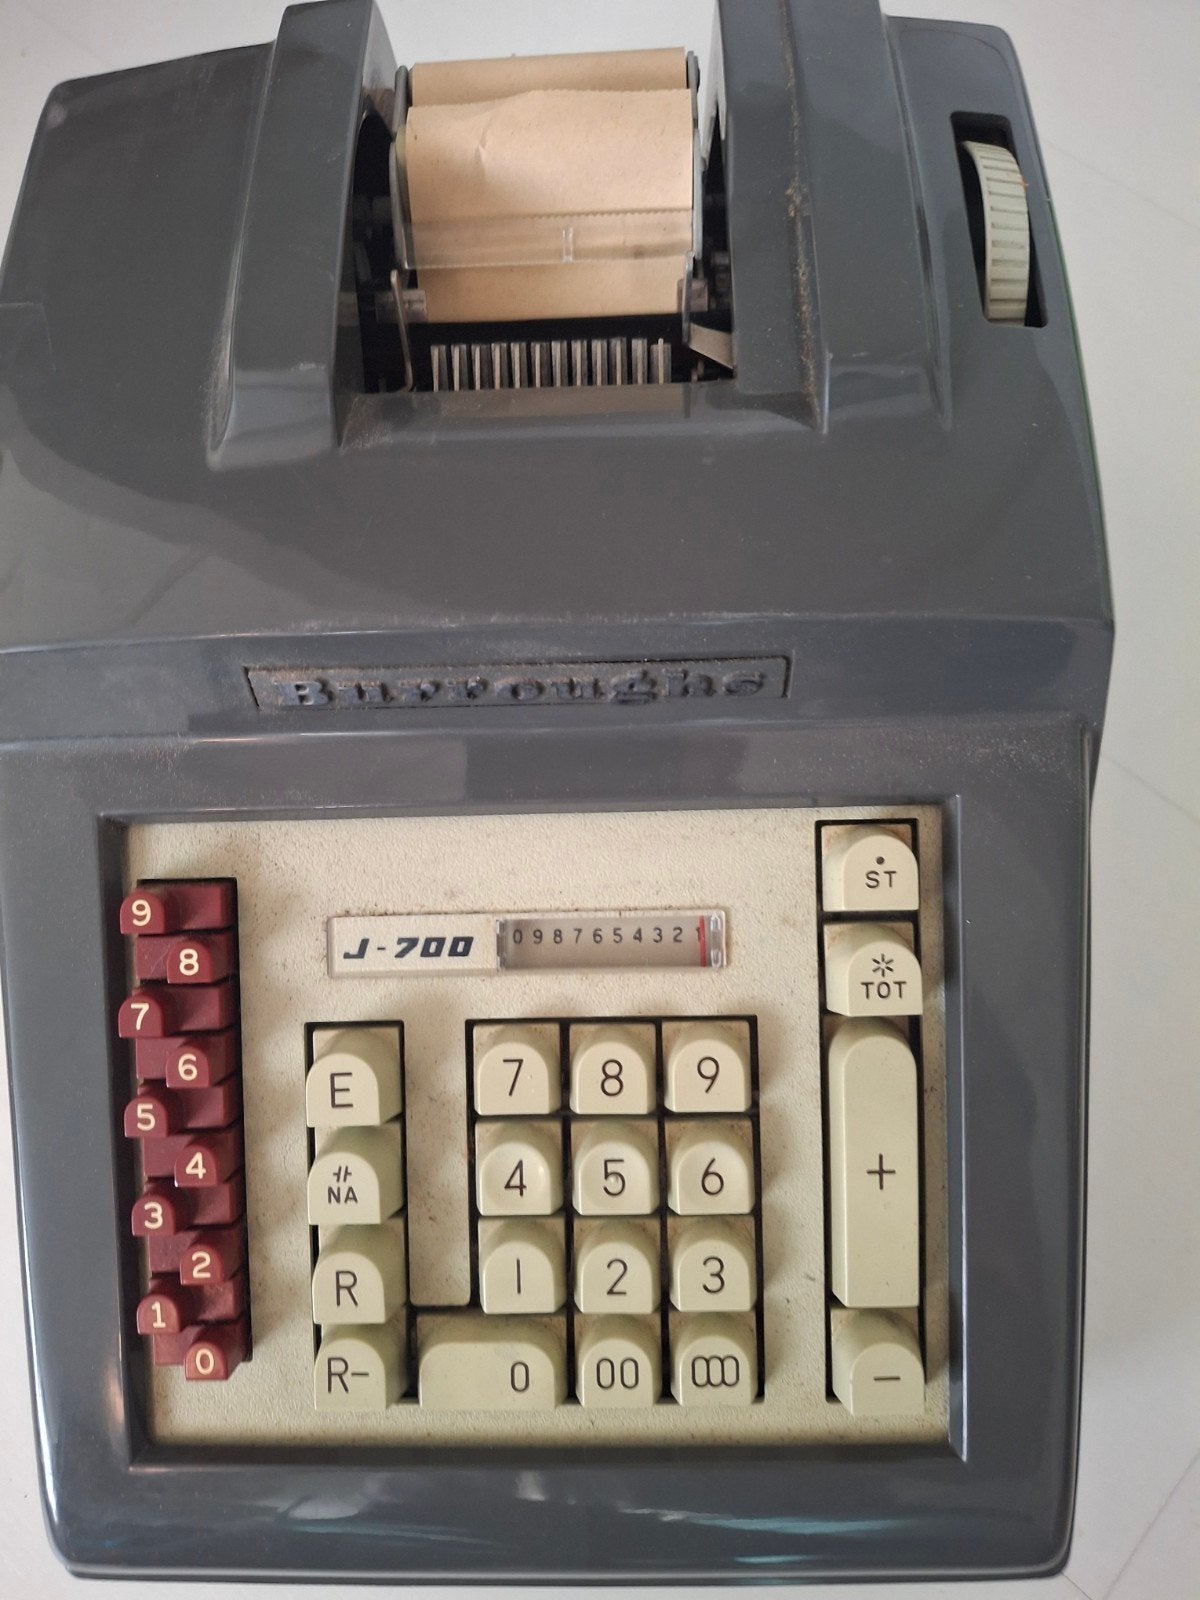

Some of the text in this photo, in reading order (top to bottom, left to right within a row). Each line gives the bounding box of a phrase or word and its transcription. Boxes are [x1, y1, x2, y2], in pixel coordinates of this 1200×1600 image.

[273, 668, 766, 706] Burroughs
[865, 870, 897, 889] ST
[131, 899, 152, 927] 9
[179, 948, 199, 976] 8
[343, 935, 475, 960] J-700
[860, 980, 907, 999] TOT
[130, 1002, 150, 1031] 7
[178, 1053, 198, 1081] 6
[502, 1058, 524, 1097] 7
[600, 1059, 624, 1097] 8
[696, 1056, 720, 1094] 9
[329, 1071, 354, 1109] E
[136, 1103, 156, 1131] 5
[185, 1152, 207, 1179] 4
[503, 1159, 527, 1197] 4
[602, 1158, 626, 1197] 5
[701, 1158, 725, 1196] 6
[327, 1186, 358, 1204] NA
[144, 1201, 163, 1230] 3
[191, 1251, 211, 1278] 2
[605, 1258, 629, 1296] 2
[702, 1256, 726, 1294] 3
[335, 1270, 359, 1307] R
[151, 1301, 166, 1328] 1
[195, 1348, 215, 1375] 0
[596, 1357, 640, 1390] 00
[510, 1361, 530, 1393] 0
